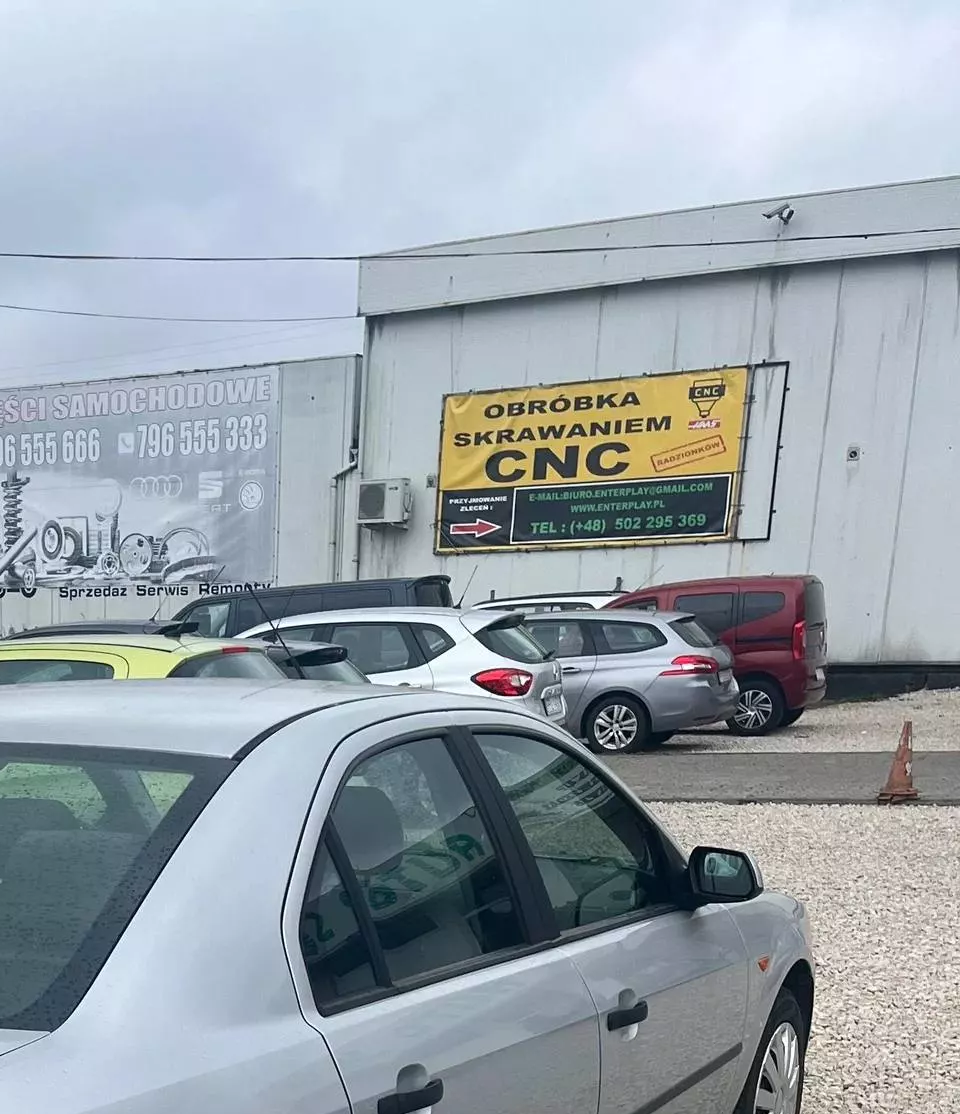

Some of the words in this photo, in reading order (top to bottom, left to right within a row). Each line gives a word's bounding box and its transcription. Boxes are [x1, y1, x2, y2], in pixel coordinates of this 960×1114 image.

[52, 375, 271, 420] SAMOCHODOWE
[483, 391, 641, 419] OBRÓBKA
[694, 386, 720, 397] CNC
[137, 421, 175, 458] 796
[179, 418, 220, 455] 555
[225, 413, 268, 451] 333
[453, 415, 672, 447] SKRAWANIEM
[20, 431, 57, 466] 555
[62, 428, 101, 464] 666
[485, 441, 631, 484] CNC
[570, 500, 666, 513] WWW.ENTERPLAY.PL
[530, 521, 558, 535] TEL
[569, 518, 606, 536] (+48)
[614, 516, 641, 530] 502
[645, 515, 673, 529] 295
[677, 513, 707, 528] 369
[135, 583, 189, 597] Serwis
